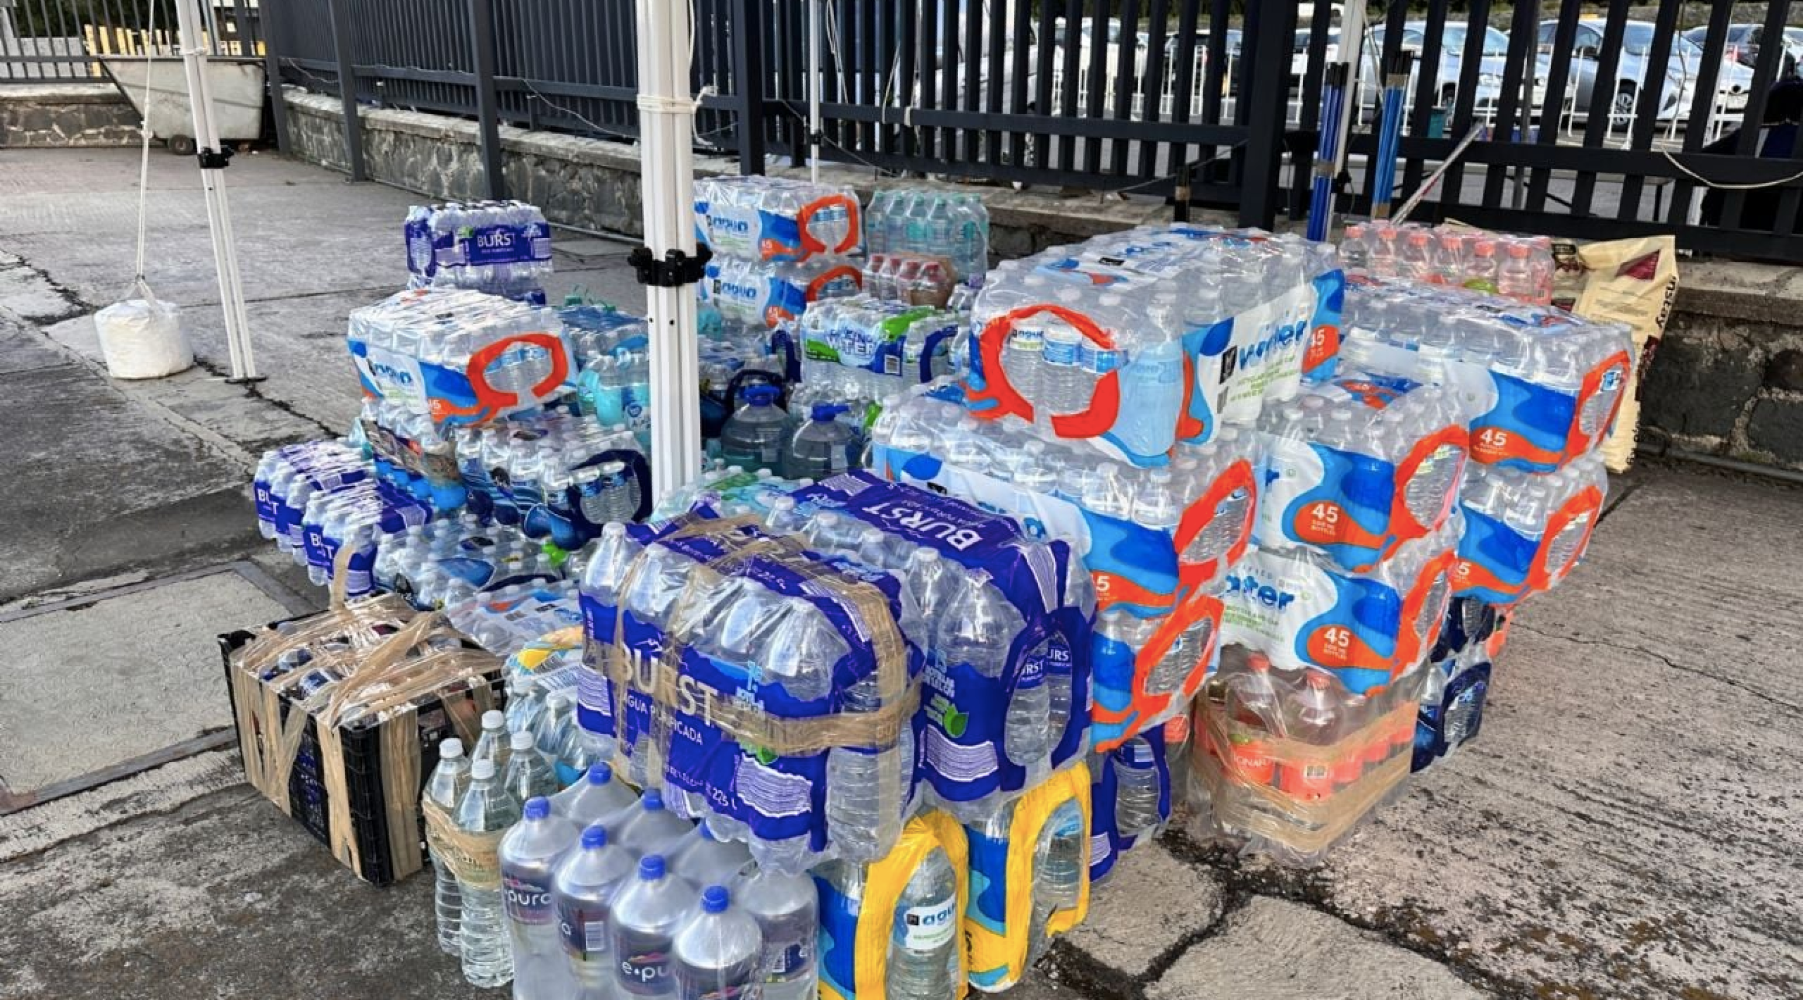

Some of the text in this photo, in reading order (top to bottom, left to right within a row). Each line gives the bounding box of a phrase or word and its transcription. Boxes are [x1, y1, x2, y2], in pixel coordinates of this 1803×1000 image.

[477, 233, 515, 248] BURST
[1480, 429, 1507, 446] 45
[1311, 502, 1339, 524] 45
[862, 502, 983, 552] BURST
[1458, 561, 1471, 576] 5
[1096, 575, 1110, 591] 5
[1225, 574, 1295, 611] ater
[1324, 627, 1349, 648] 45
[1047, 648, 1070, 662] URS
[616, 641, 719, 728] BURST
